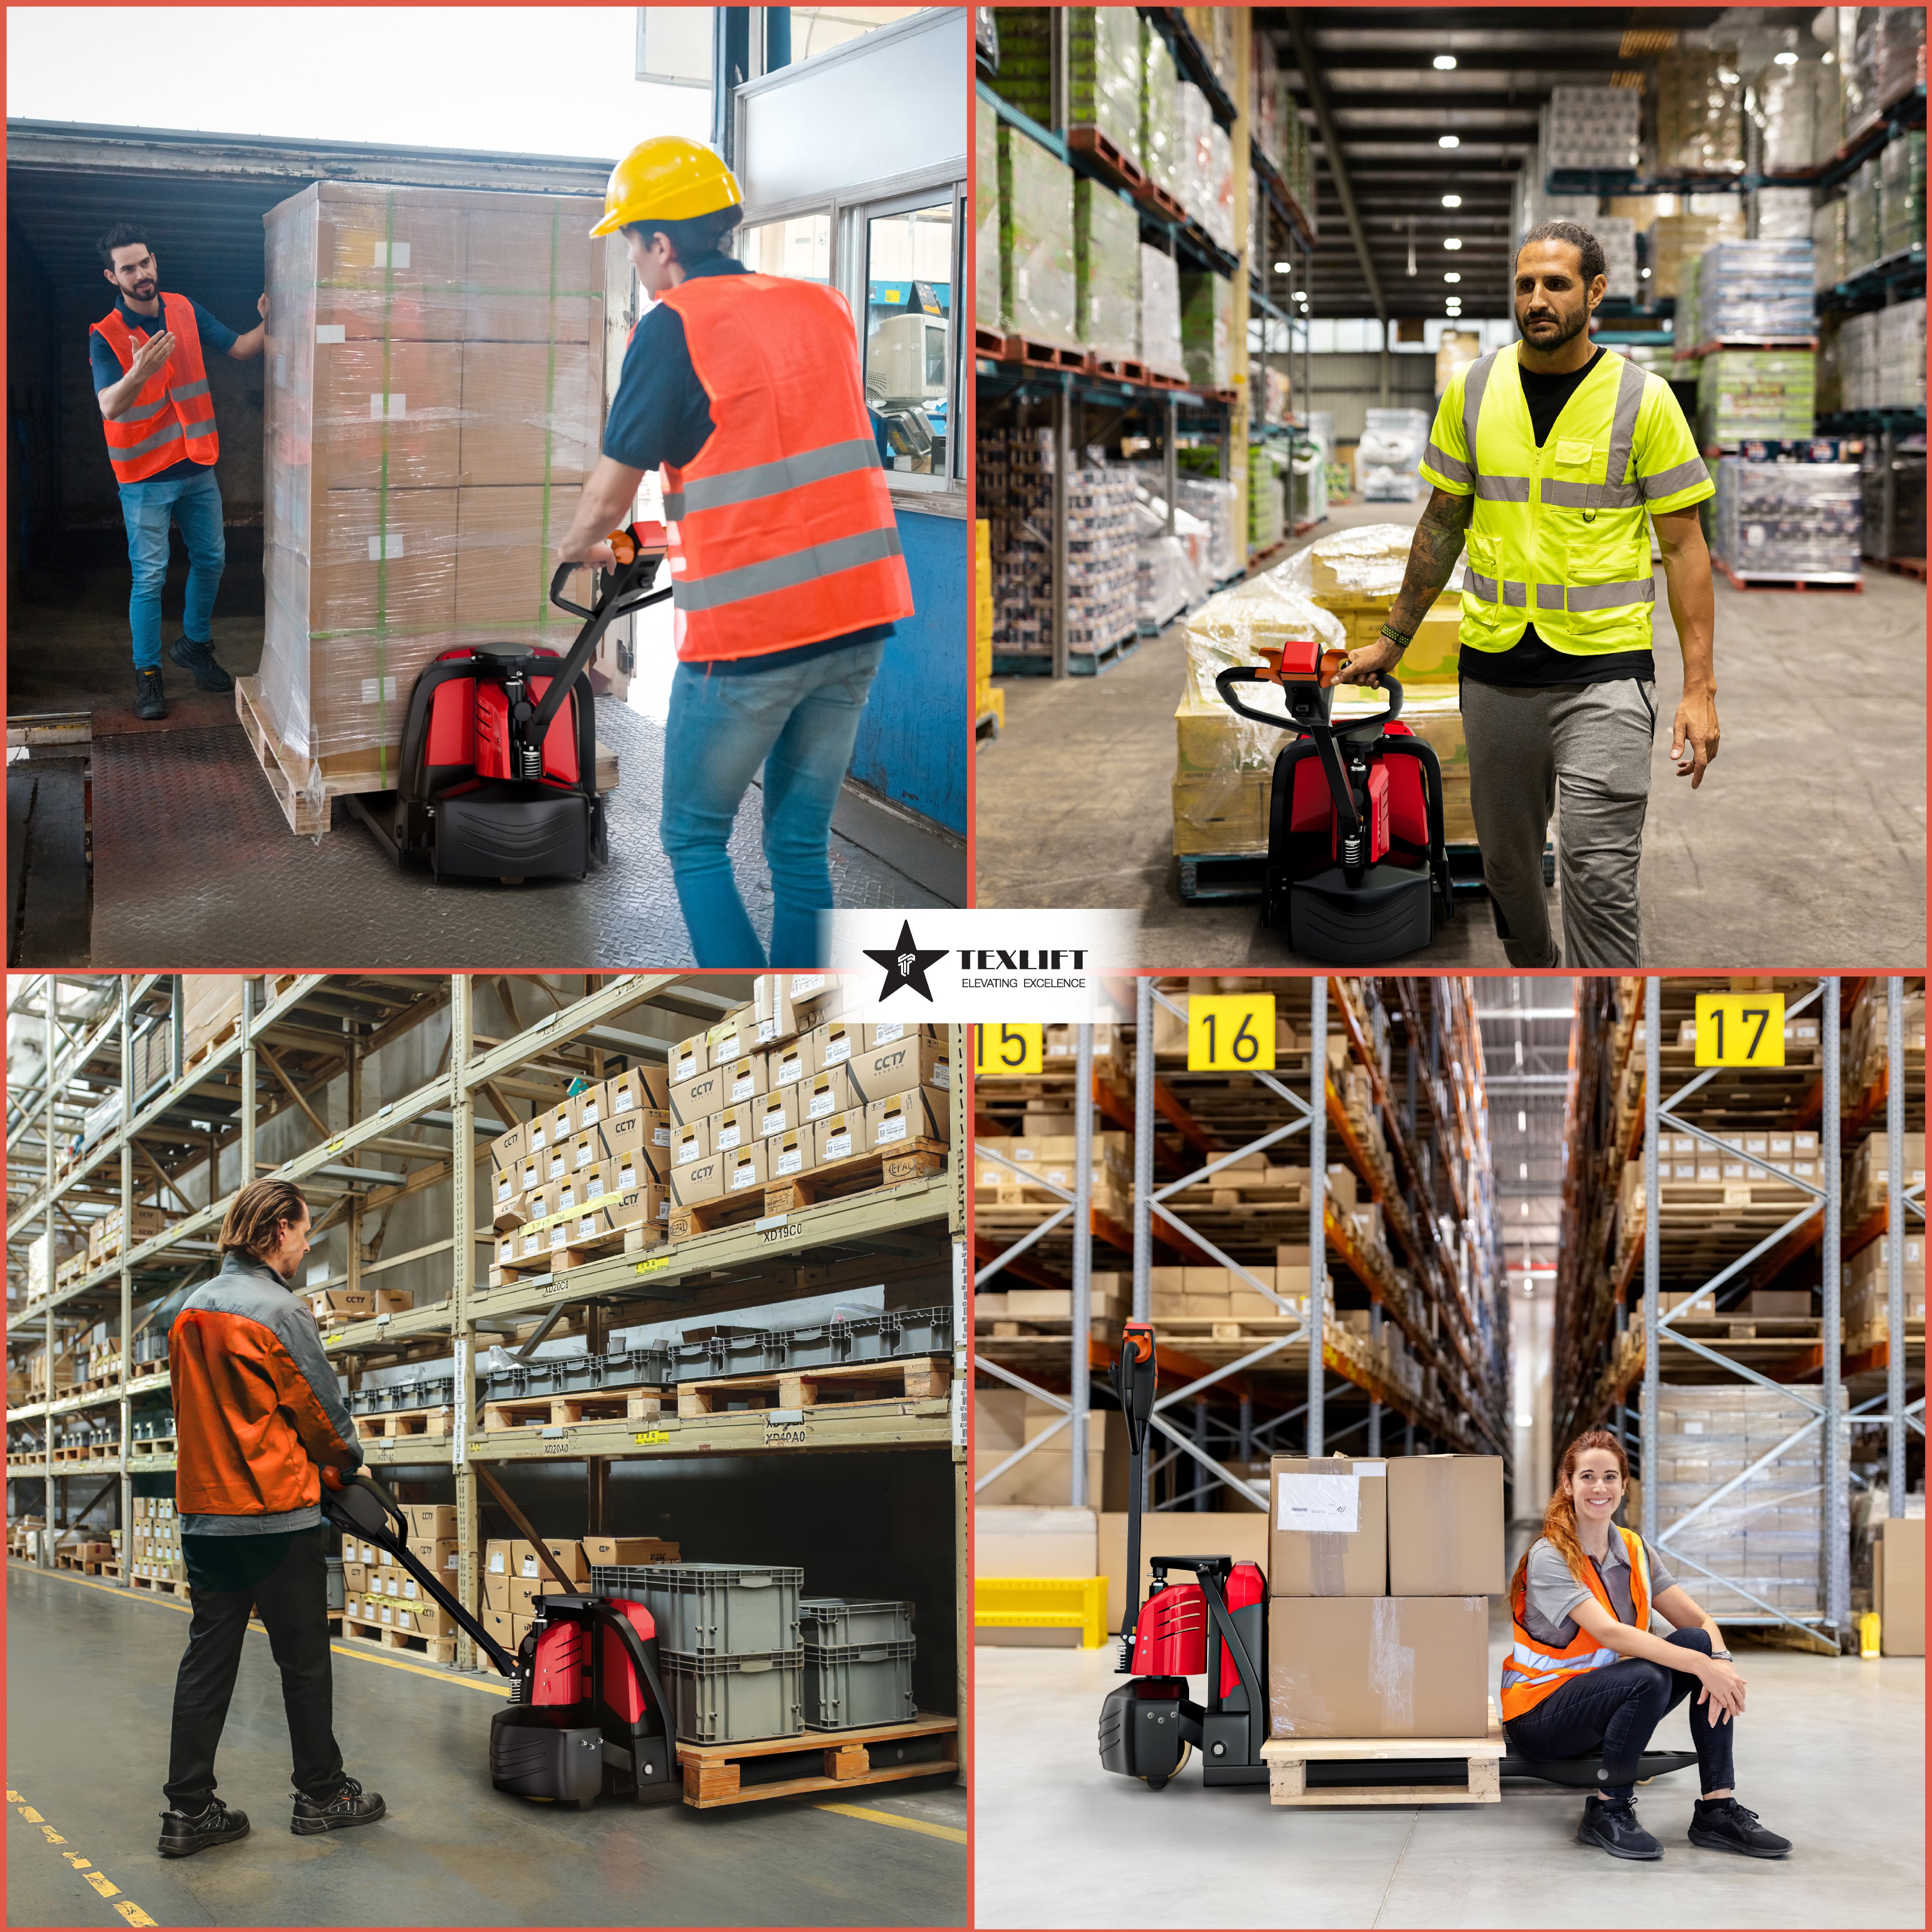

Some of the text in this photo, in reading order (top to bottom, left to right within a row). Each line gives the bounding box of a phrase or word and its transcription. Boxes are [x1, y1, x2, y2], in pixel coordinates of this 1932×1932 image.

[1203, 1014, 1259, 1063] 16
[1710, 1009, 1770, 1059] 17
[974, 1023, 1026, 1066] 15
[874, 1049, 906, 1071] CCTY
[691, 1079, 714, 1098] CCTY
[616, 1118, 636, 1133] CCTY
[504, 1132, 518, 1148] CCTY
[691, 1164, 714, 1181] CCTY
[763, 1223, 802, 1243] XD19C0
